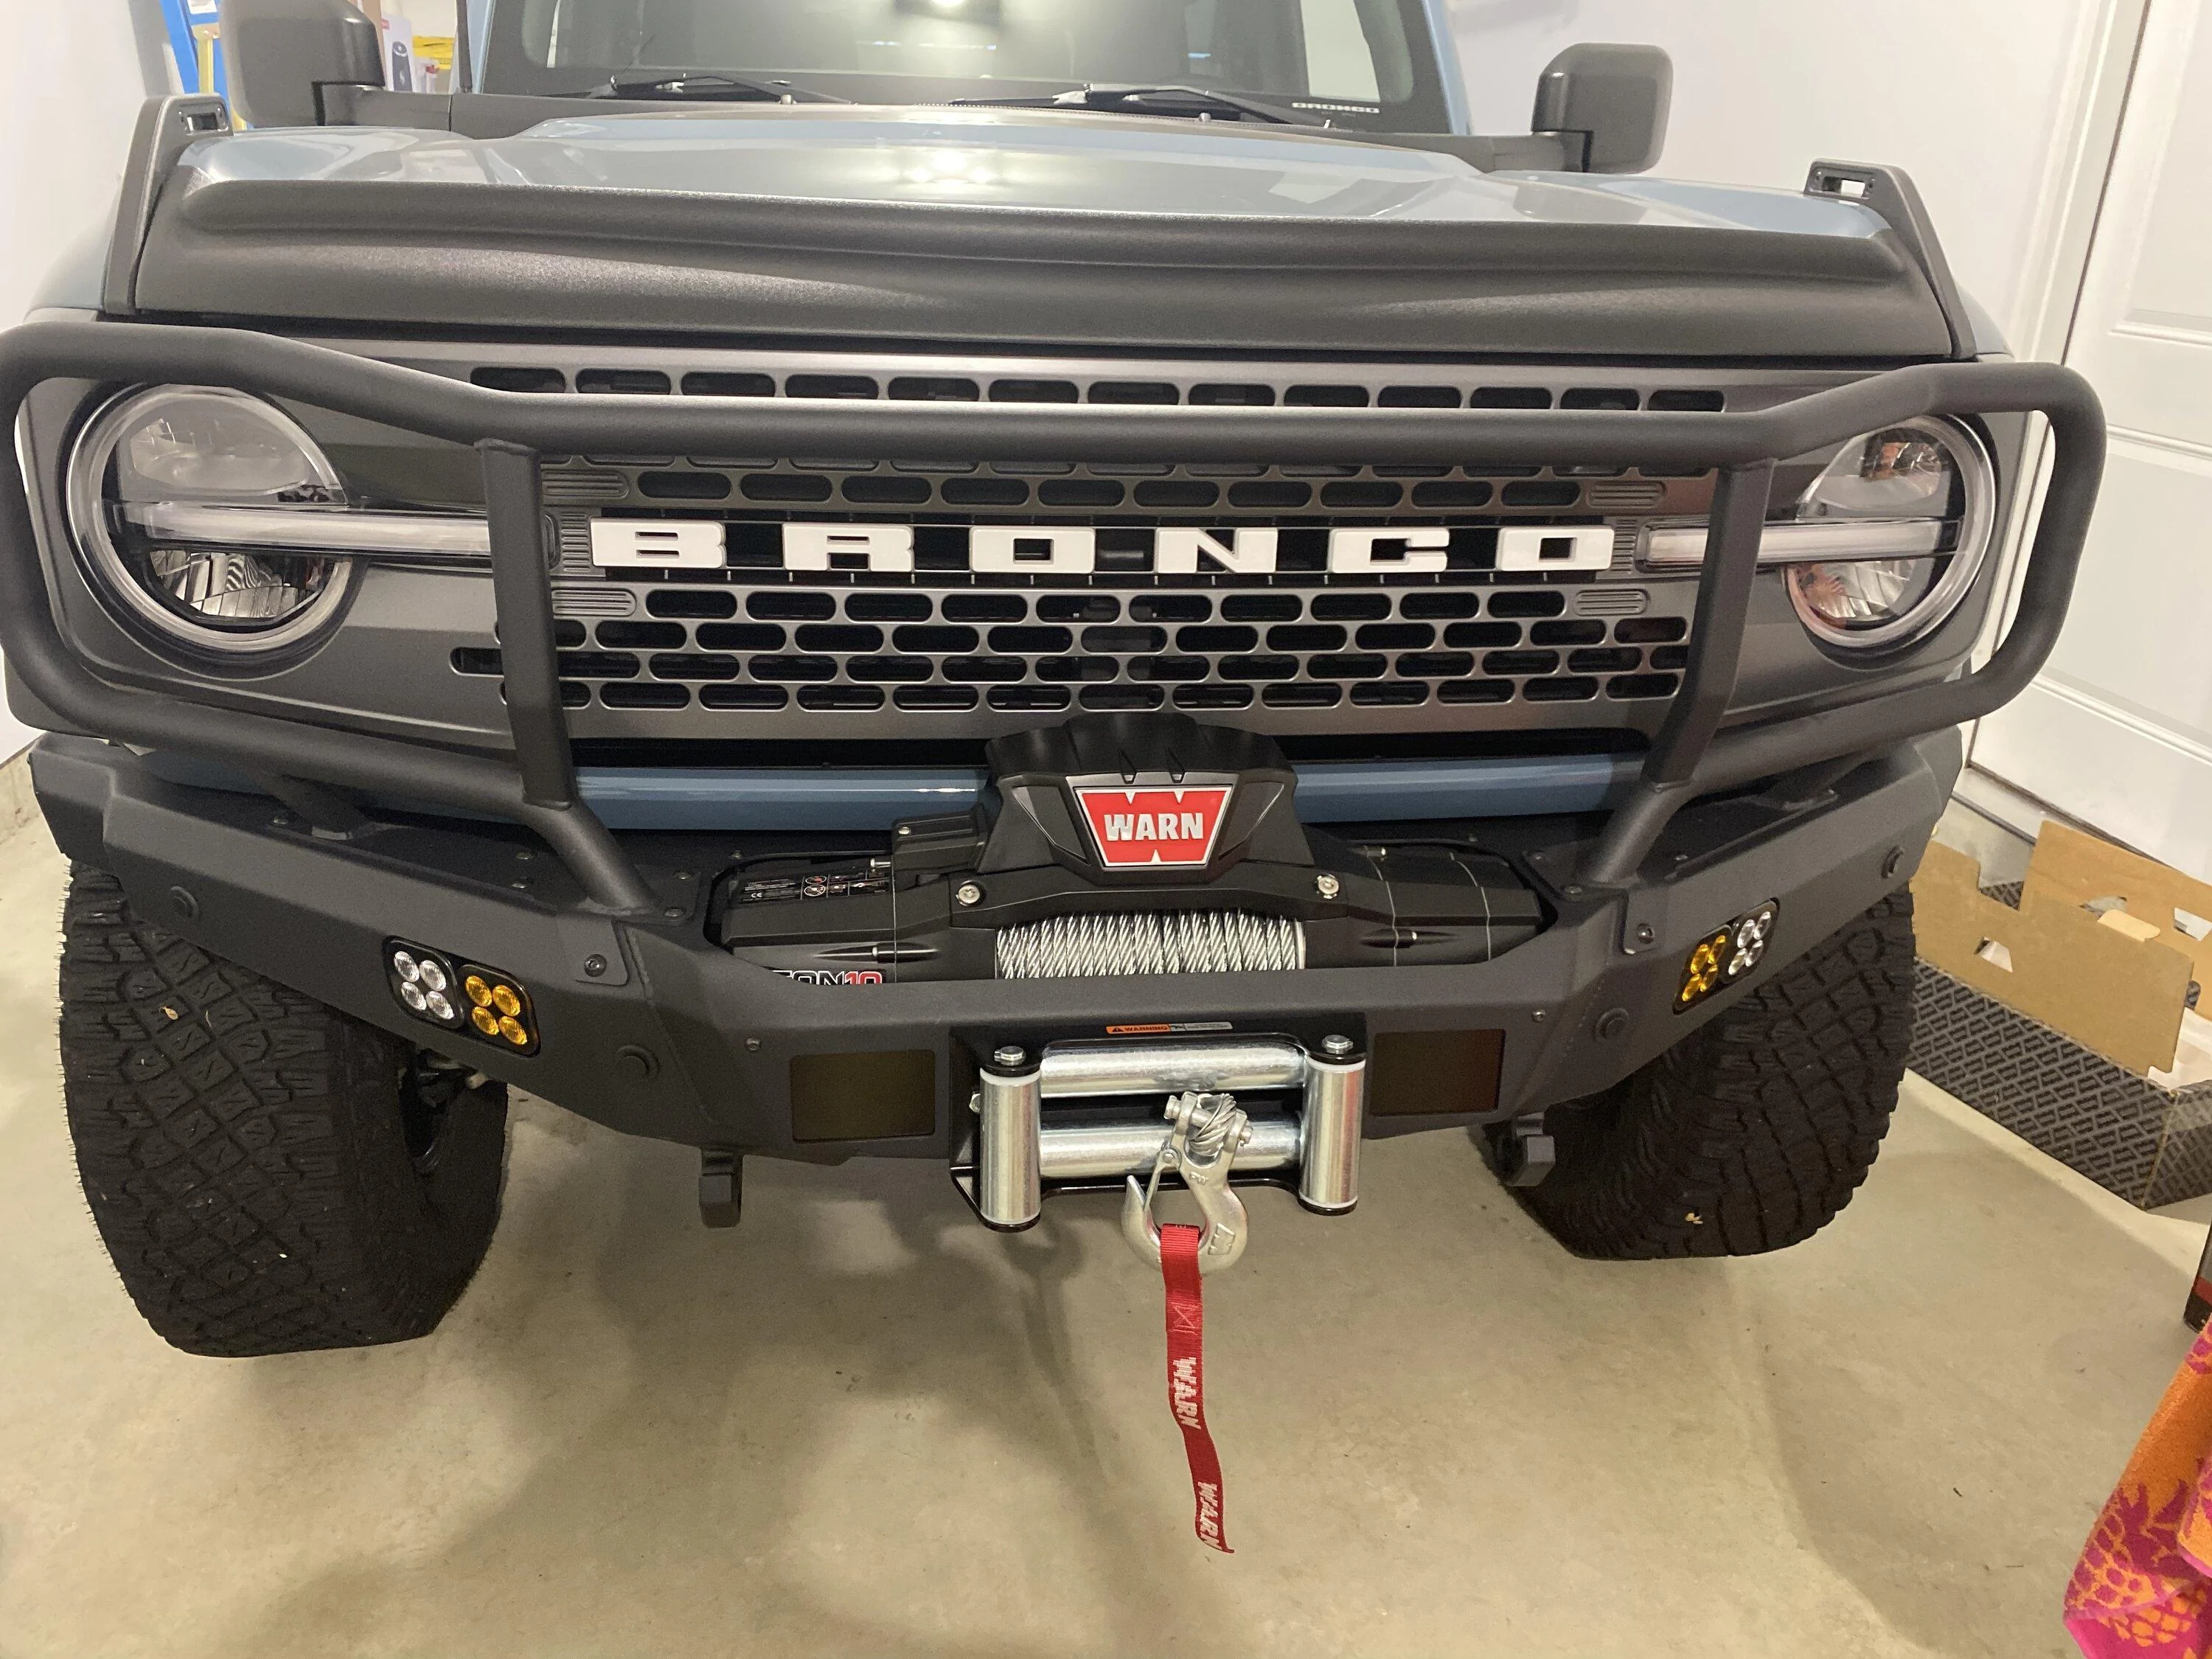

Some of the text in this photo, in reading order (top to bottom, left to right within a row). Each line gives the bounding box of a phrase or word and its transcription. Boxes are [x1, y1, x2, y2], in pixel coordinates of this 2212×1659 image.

[590, 518, 1615, 574] BRONCO
[1104, 813, 1203, 841] WARN
[1172, 1357, 1202, 1430] WARN
[1197, 1481, 1223, 1551] WARN
